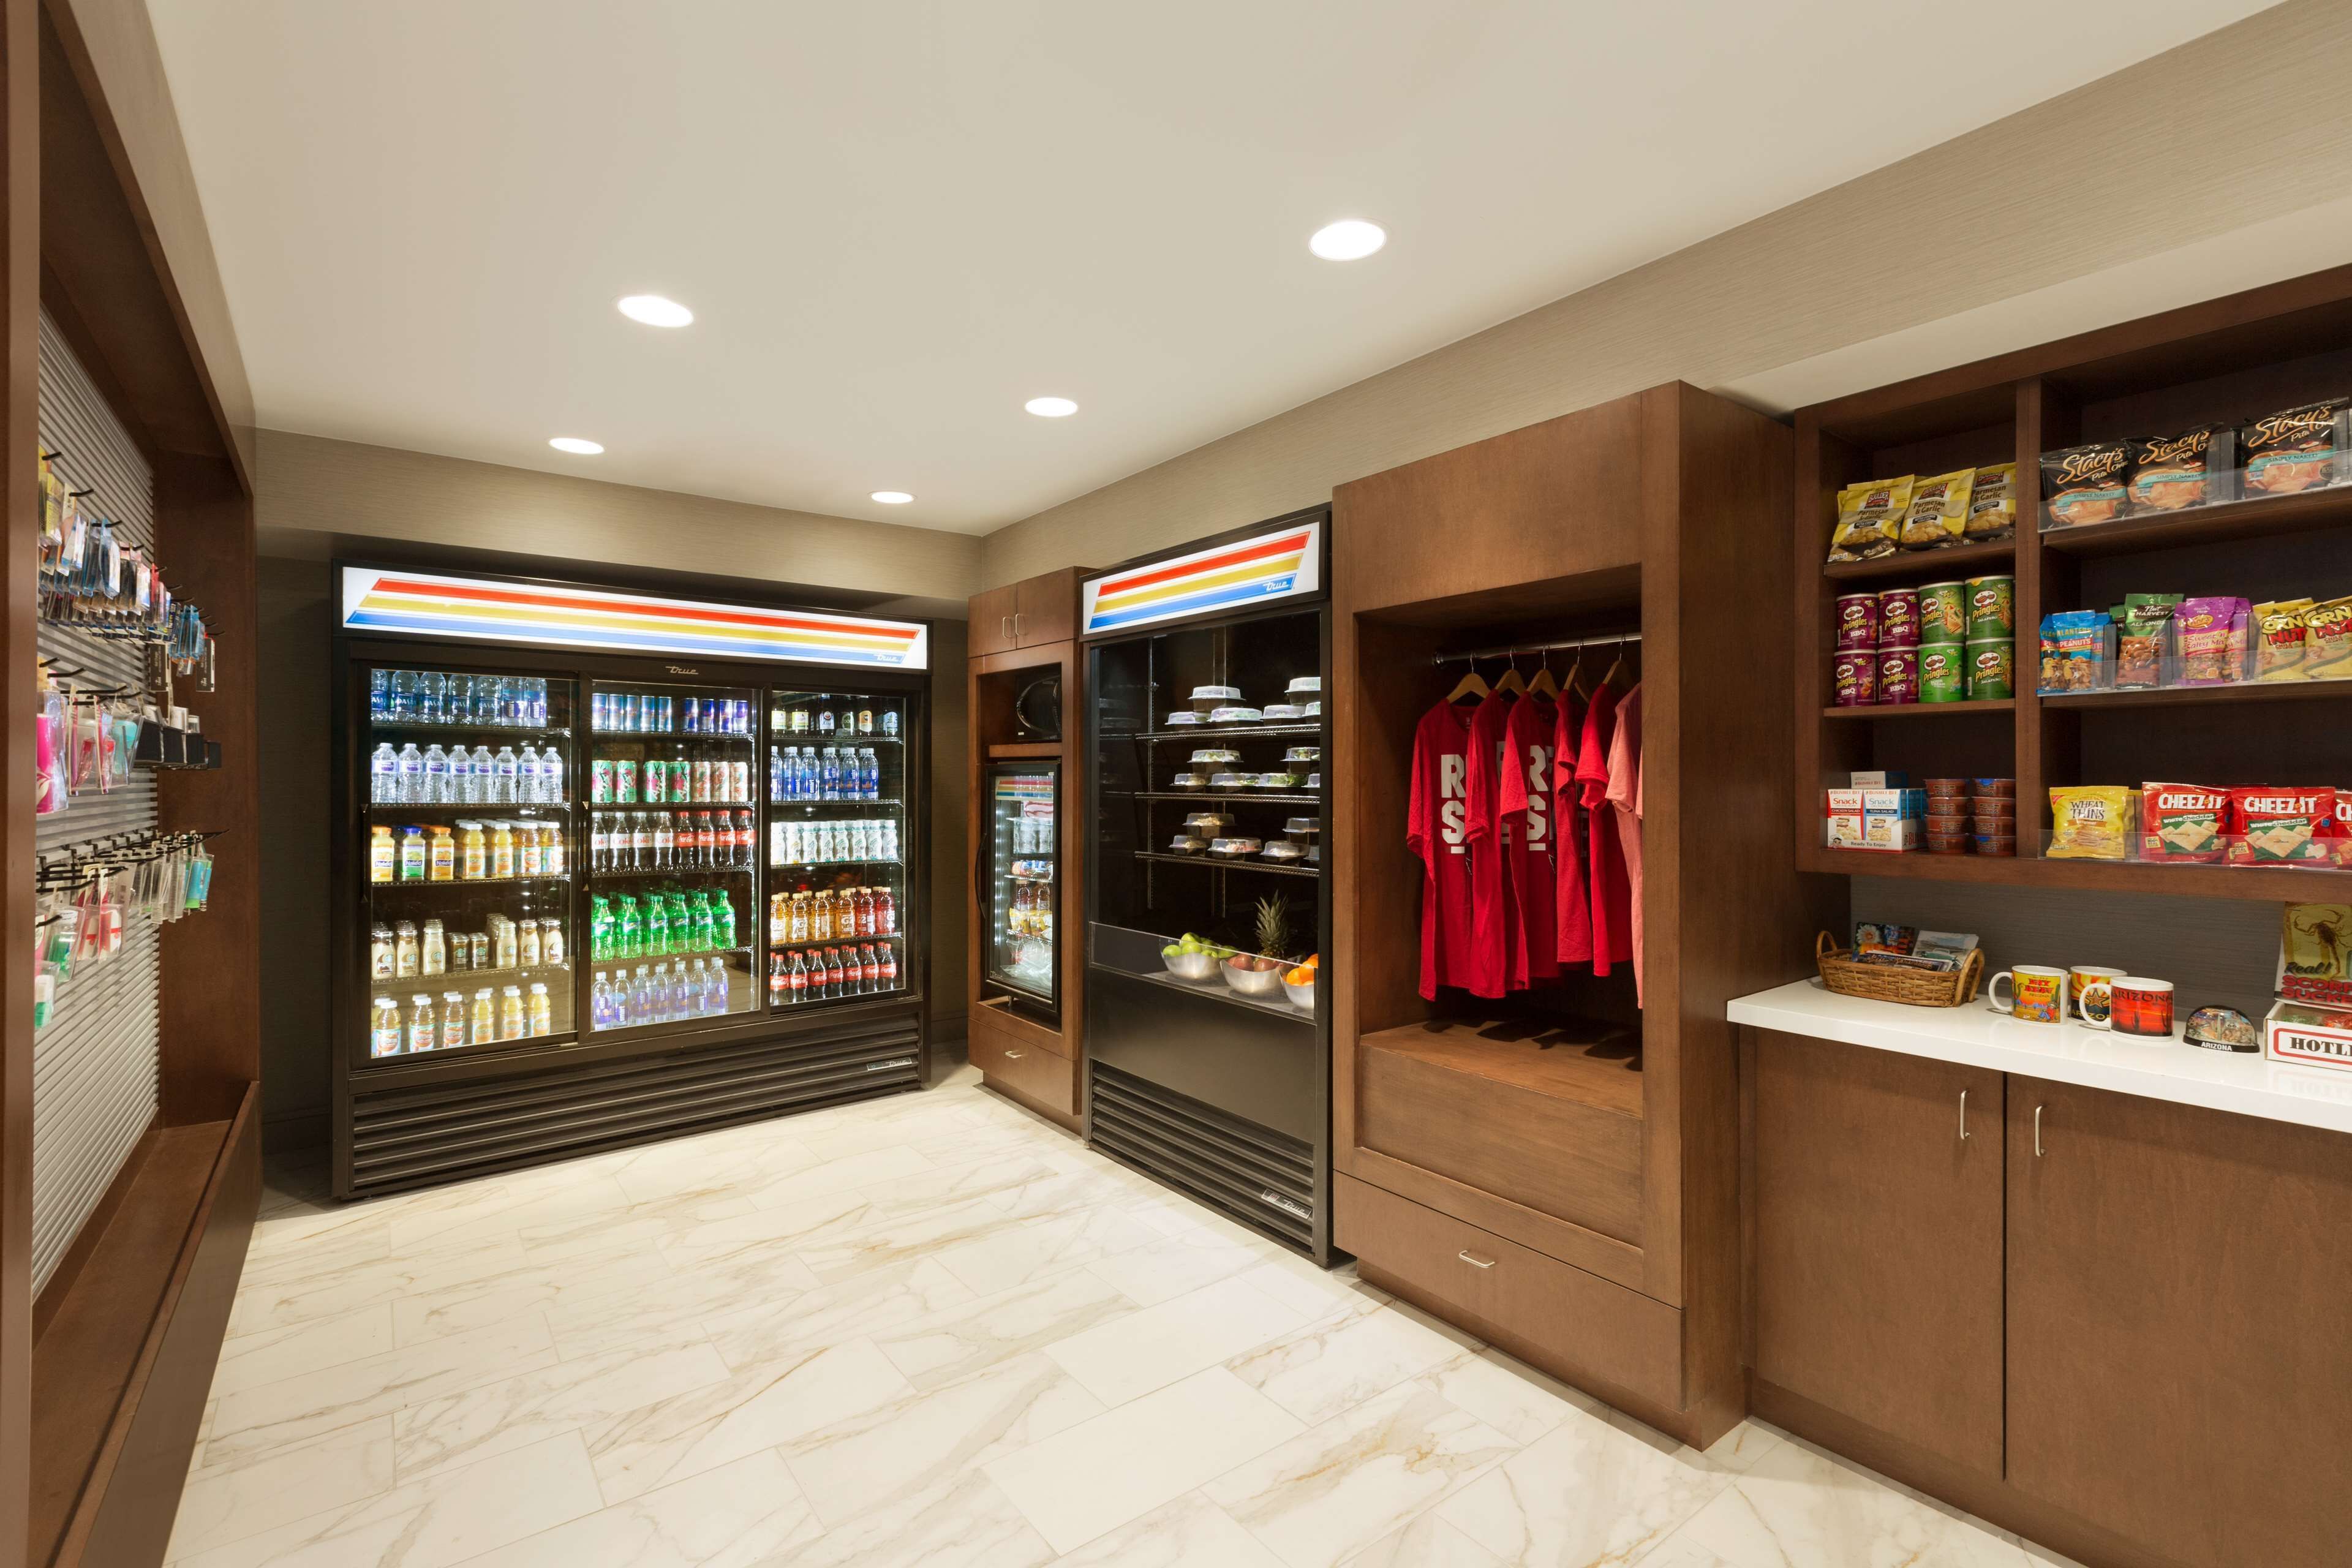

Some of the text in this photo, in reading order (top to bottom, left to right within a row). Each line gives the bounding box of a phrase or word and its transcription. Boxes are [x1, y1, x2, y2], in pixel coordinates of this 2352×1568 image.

[2248, 406, 2332, 448] Stacy's
[2138, 429, 2210, 465] Stacy's
[2057, 448, 2125, 484] Stacy's
[1913, 500, 1945, 509] Parmesan
[1980, 492, 2002, 501] Garlic
[1972, 604, 2000, 622] Pringles
[2304, 606, 2352, 628] CORN
[1842, 617, 1868, 634] Pringles
[1885, 614, 1910, 630] Pringles
[1892, 625, 1909, 634] BBQ
[2316, 619, 2352, 639] NUT
[1850, 628, 1866, 638] BBQ
[2268, 627, 2306, 645] NUT
[2060, 638, 2092, 647] PEANUTS
[1882, 673, 1907, 688] Pringles
[1923, 668, 1950, 685] Pringles
[1975, 666, 2003, 683] Pringles
[1841, 687, 1856, 696] BBQ
[2070, 809, 2105, 820] THINS
[2285, 962, 2332, 974] Real!
[2282, 975, 2352, 993] SCORP
[2113, 989, 2173, 1002] ARIZONA
[2281, 987, 2352, 1004] SUCKE
[2072, 1009, 2111, 1019] ARZO
[2201, 1041, 2233, 1052] ARIZONA
